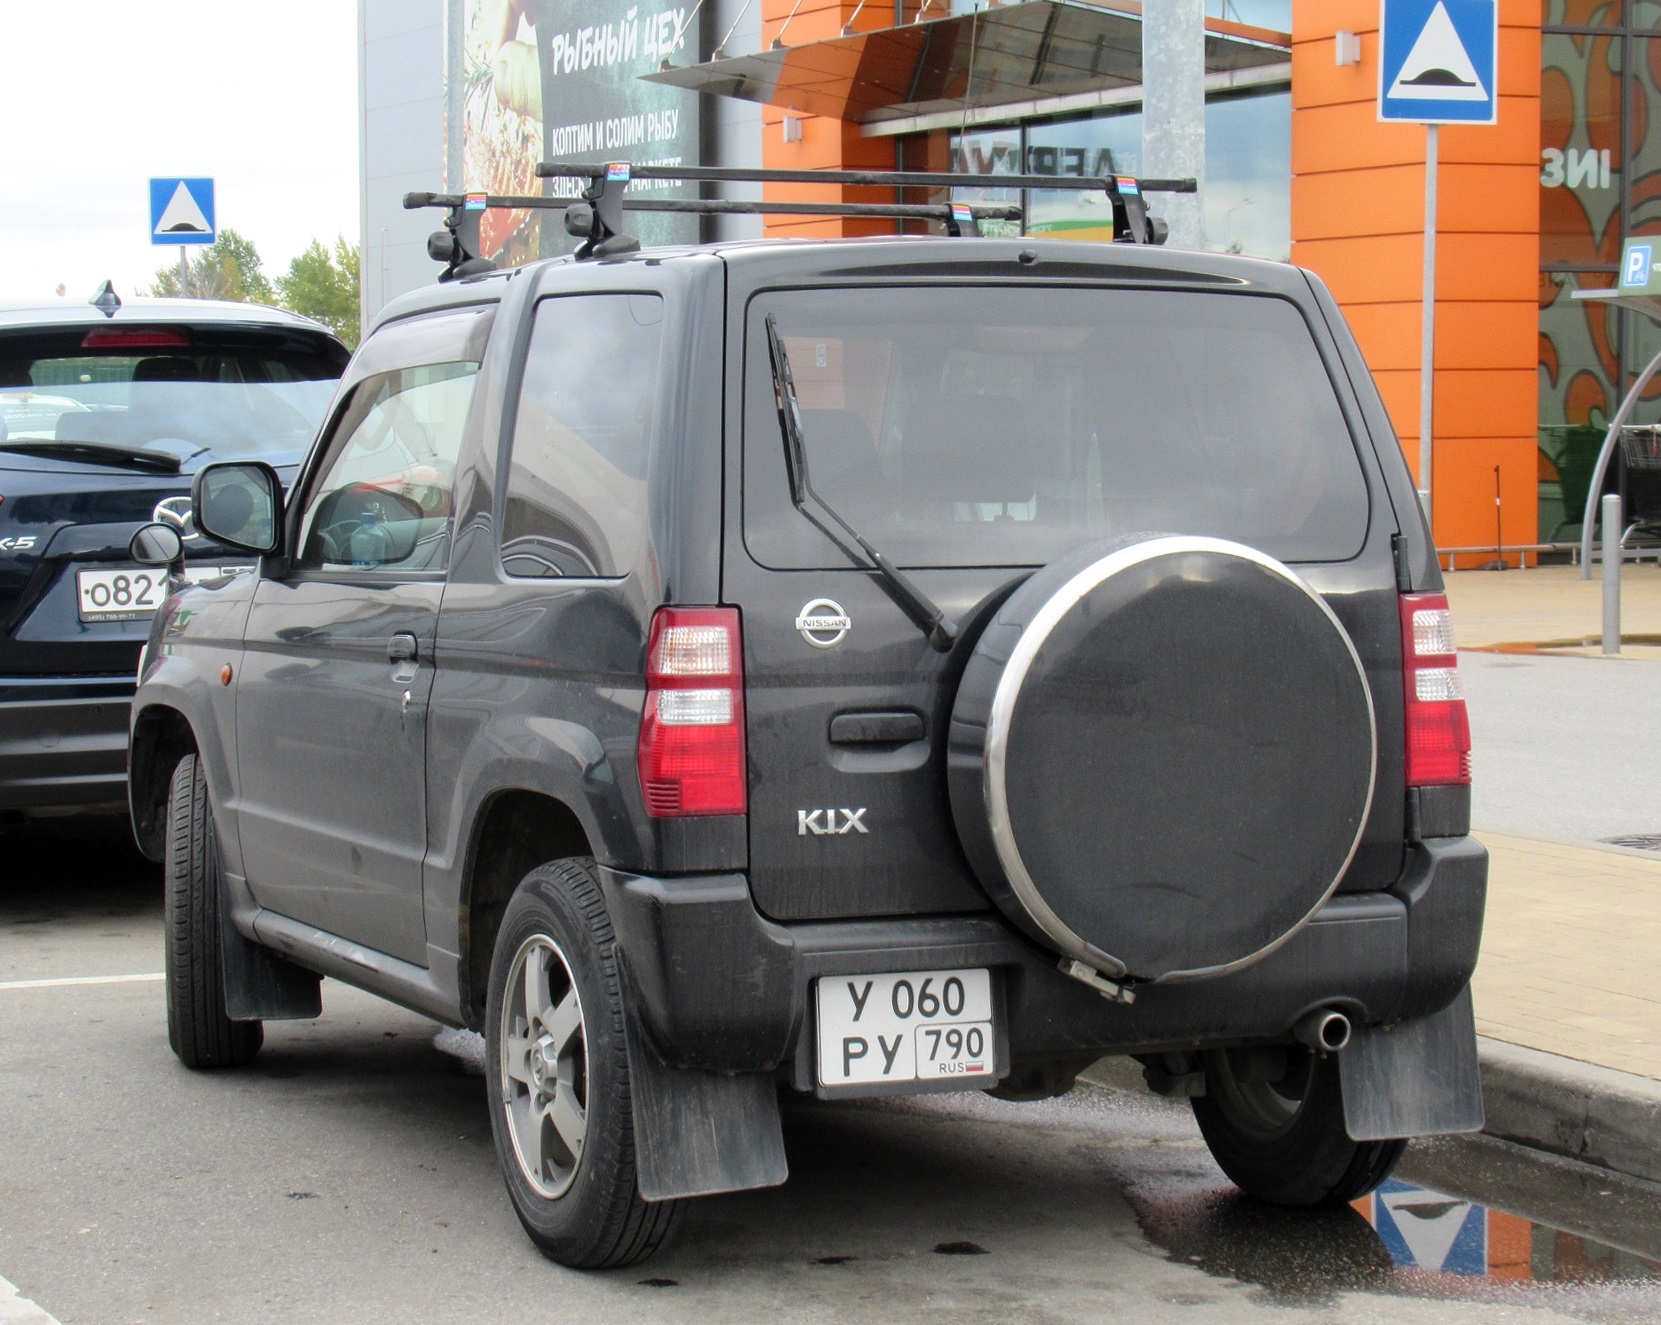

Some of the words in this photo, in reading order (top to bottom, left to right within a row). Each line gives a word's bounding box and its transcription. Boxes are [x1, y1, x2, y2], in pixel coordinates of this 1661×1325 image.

[552, 5, 639, 76] РЫБНЫЙ
[643, 7, 686, 63] ЦЕХ
[552, 122, 593, 157] КОПТИМ
[596, 121, 604, 150] И
[606, 114, 645, 149] СОЛИМ
[647, 109, 679, 142] РЫБУ
[1627, 252, 1644, 283] P
[91, 574, 168, 607] О82
[803, 619, 847, 628] NISSAN
[797, 807, 870, 836] KIX
[891, 976, 966, 1019] 060
[924, 1027, 984, 1061] 790
[939, 1061, 965, 1073] RUS
